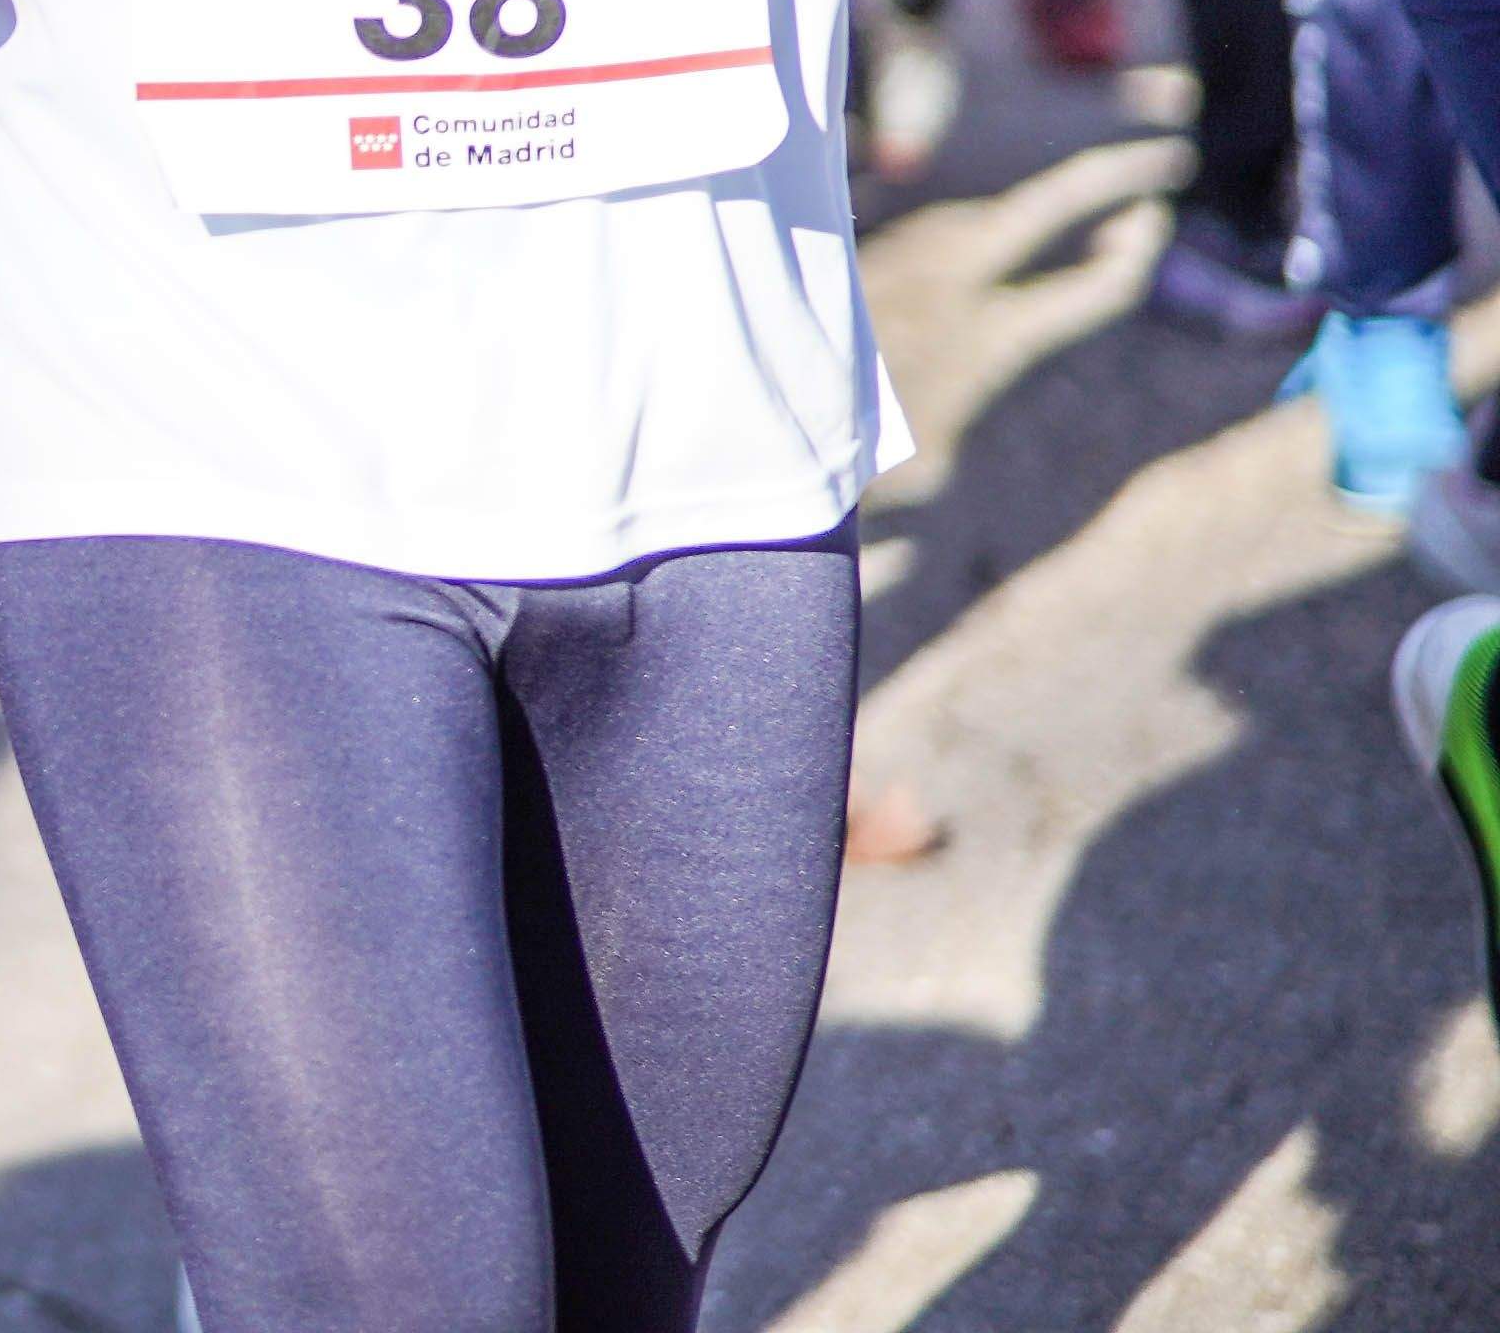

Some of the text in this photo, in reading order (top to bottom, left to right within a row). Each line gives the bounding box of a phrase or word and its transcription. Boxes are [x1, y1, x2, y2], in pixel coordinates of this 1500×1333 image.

[413, 108, 576, 134] Comunidad
[415, 139, 576, 167] de Madrid
